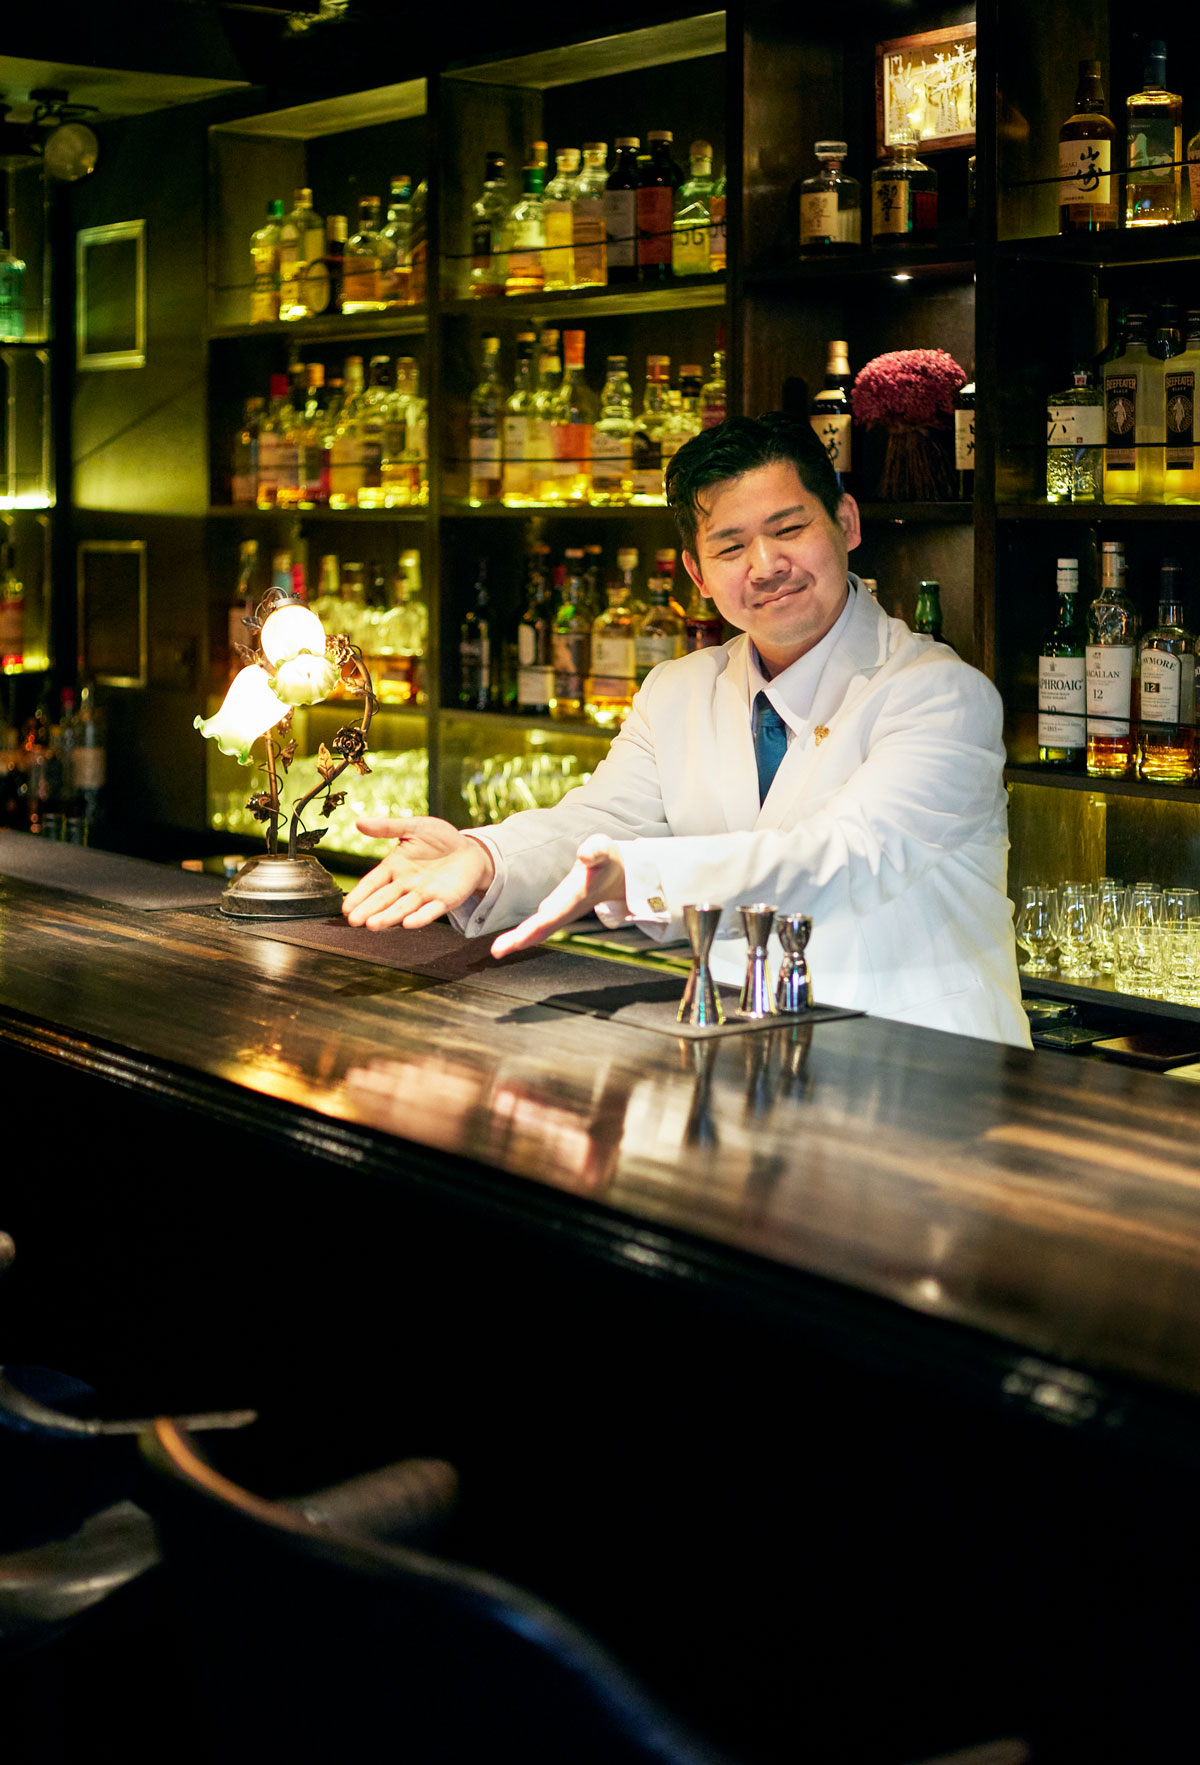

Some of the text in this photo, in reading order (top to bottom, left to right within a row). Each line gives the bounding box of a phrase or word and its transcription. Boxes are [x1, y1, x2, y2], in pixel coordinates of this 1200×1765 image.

[1106, 378, 1137, 392] BEEFEATER
[1147, 683, 1156, 692] 12
[1093, 688, 1104, 700] 12
